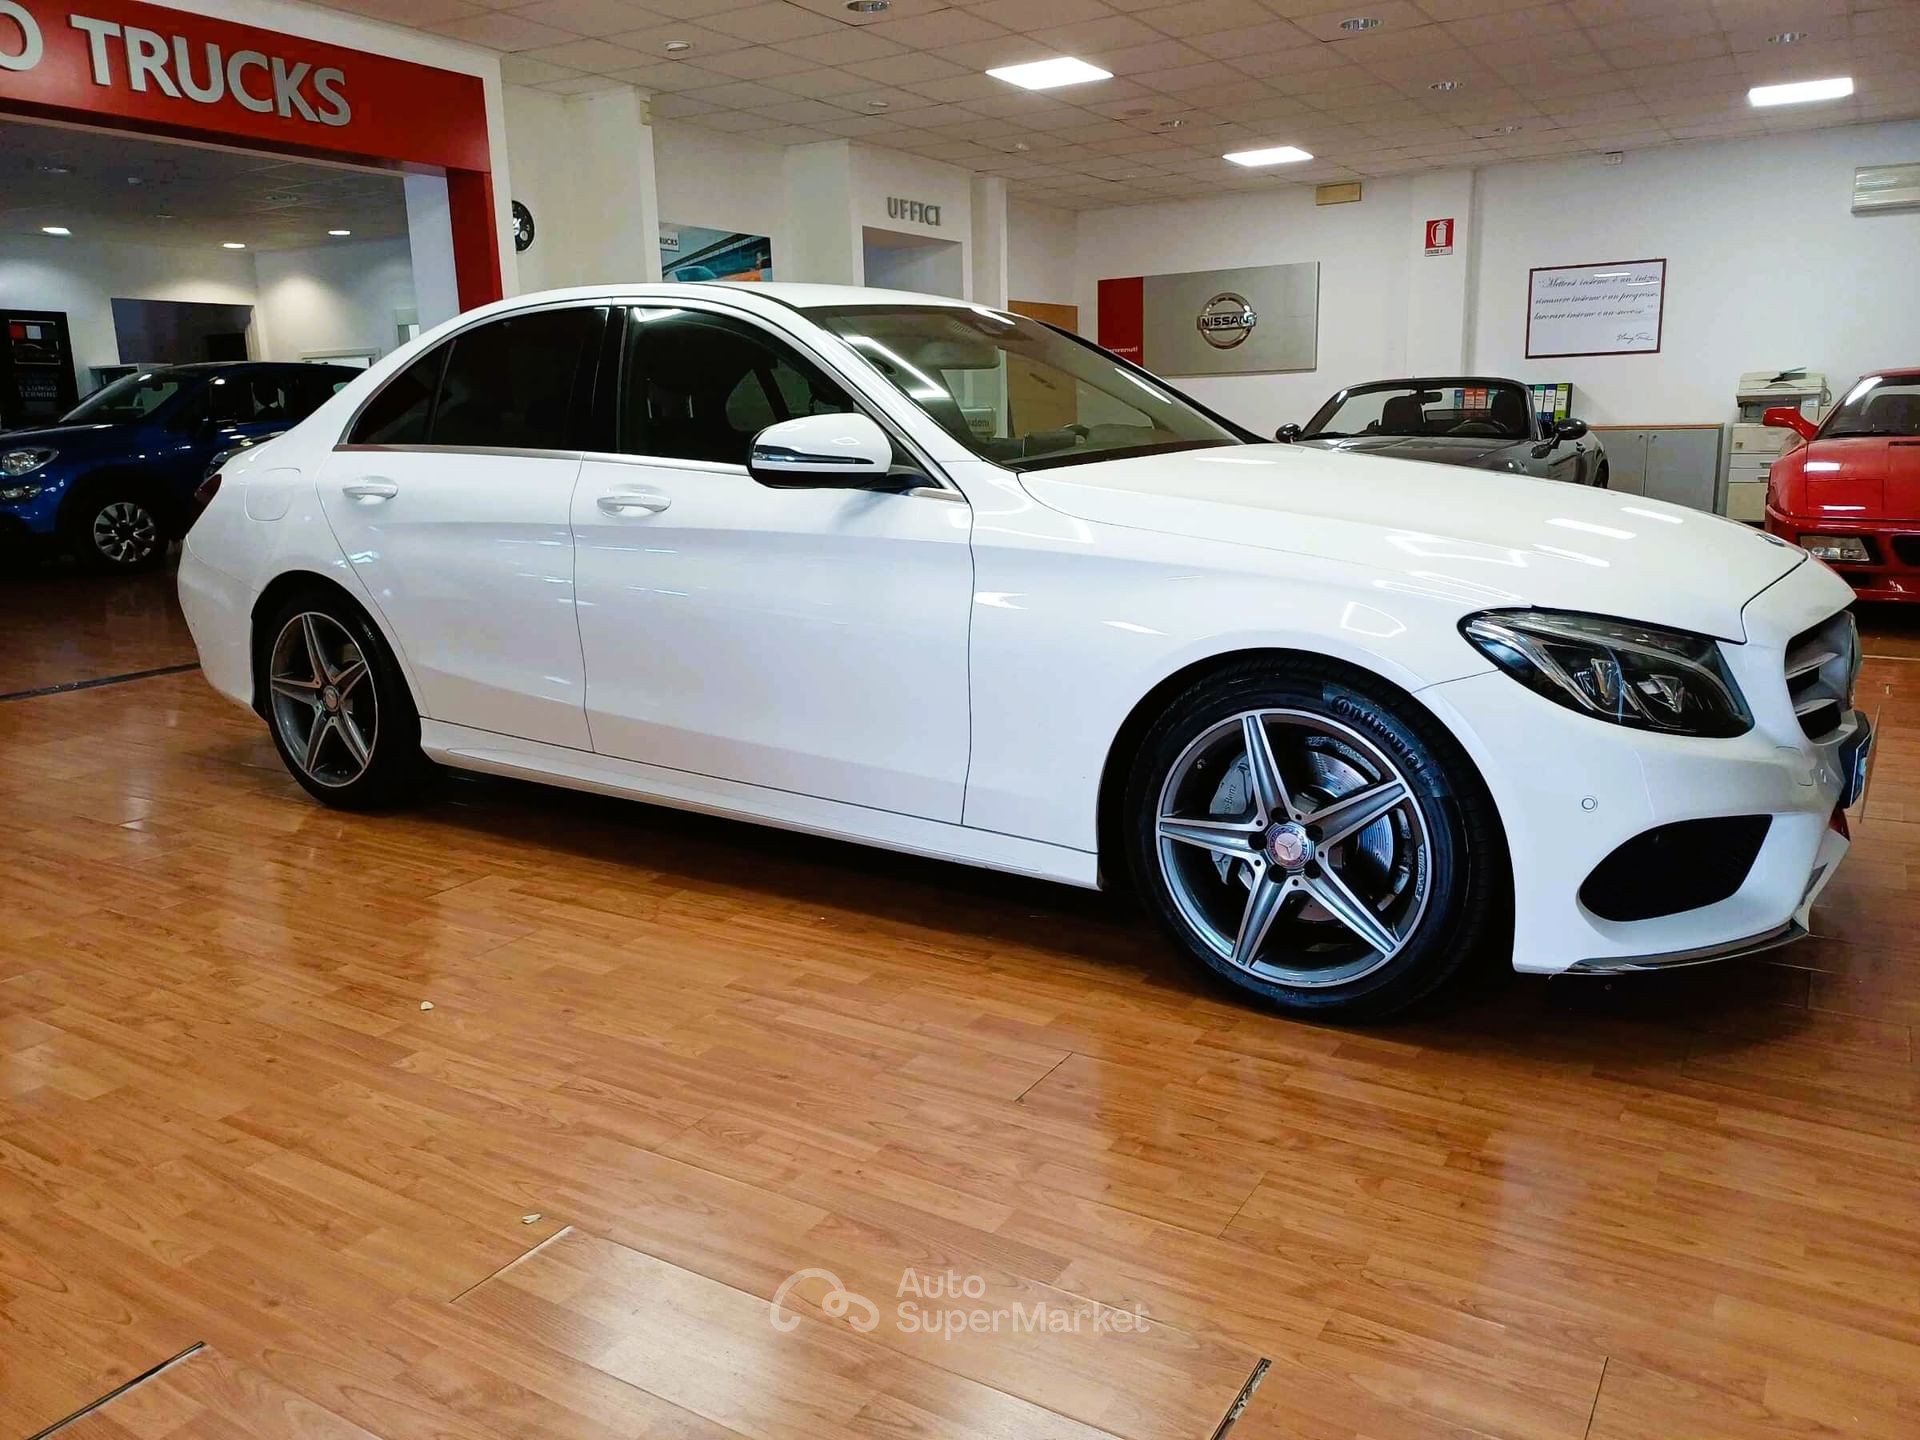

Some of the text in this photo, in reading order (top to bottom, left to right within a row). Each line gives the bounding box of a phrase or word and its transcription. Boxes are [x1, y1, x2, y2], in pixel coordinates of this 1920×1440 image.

[69, 14, 351, 126] TRUCKS
[887, 196, 941, 226] UFFICI
[1201, 315, 1251, 329] NISSAN
[1331, 696, 1427, 774] Continental
